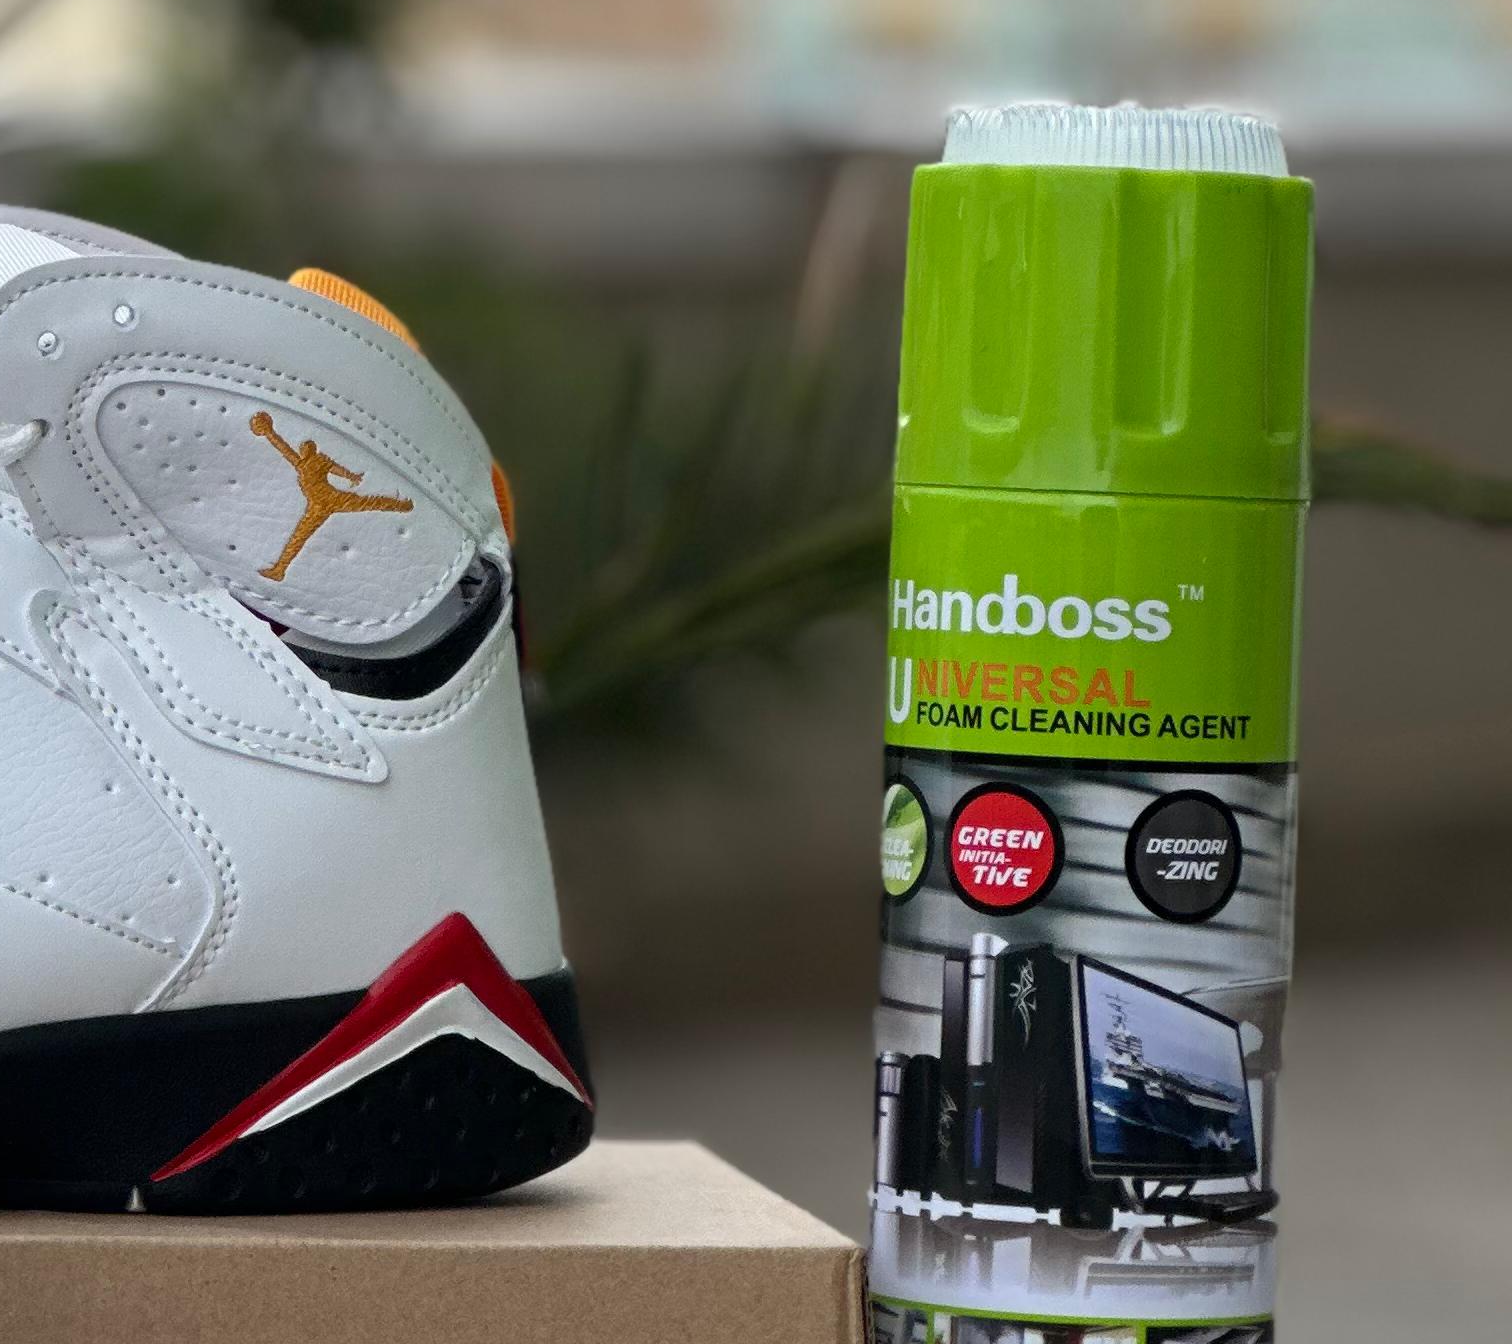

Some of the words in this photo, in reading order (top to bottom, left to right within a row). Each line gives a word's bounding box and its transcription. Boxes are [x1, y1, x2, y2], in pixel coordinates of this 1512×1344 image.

[893, 573, 1172, 642] Handboss
[889, 656, 1152, 724] UNIVERSAL
[916, 701, 983, 729] FOAM
[990, 705, 1151, 737] CLEANING
[1157, 713, 1251, 740] AGENT
[958, 825, 1044, 850] GREEN
[1146, 837, 1228, 855] DEODORI
[958, 849, 1012, 864] INITIA-
[973, 864, 1032, 887] TIVE
[1156, 860, 1220, 881] -ZING
